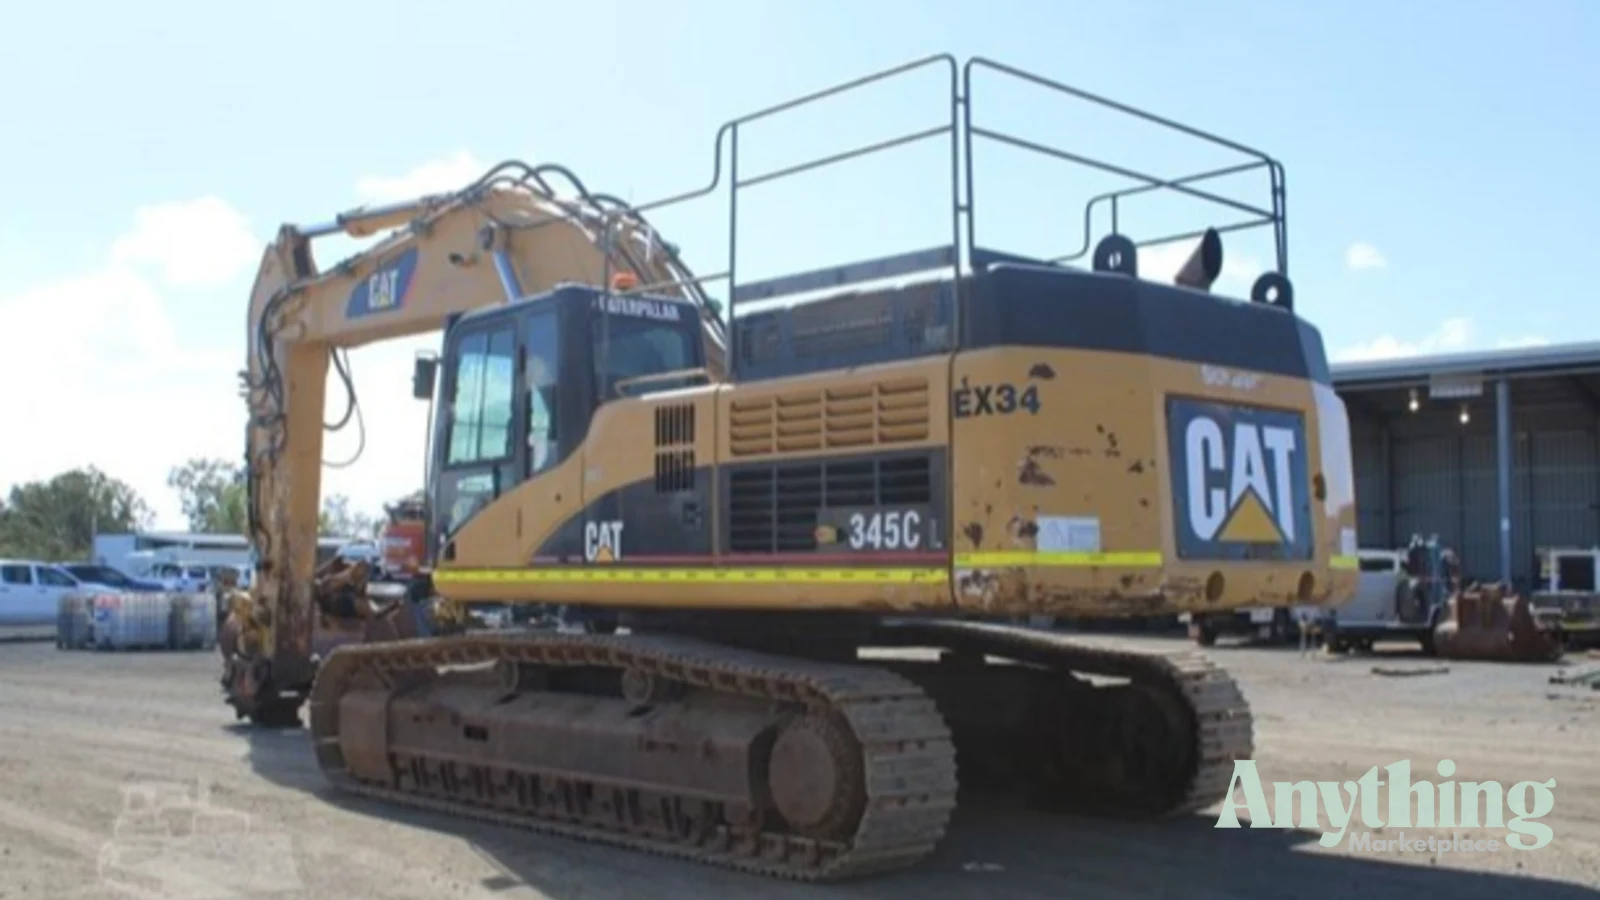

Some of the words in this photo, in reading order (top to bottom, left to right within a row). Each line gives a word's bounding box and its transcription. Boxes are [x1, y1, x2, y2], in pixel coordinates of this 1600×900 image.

[368, 269, 399, 309] CAT
[598, 294, 680, 321] CATERPILLAR
[954, 383, 1041, 418] EX34
[1185, 416, 1295, 542] CAT
[585, 520, 624, 561] CAT
[849, 510, 921, 550] 345C
